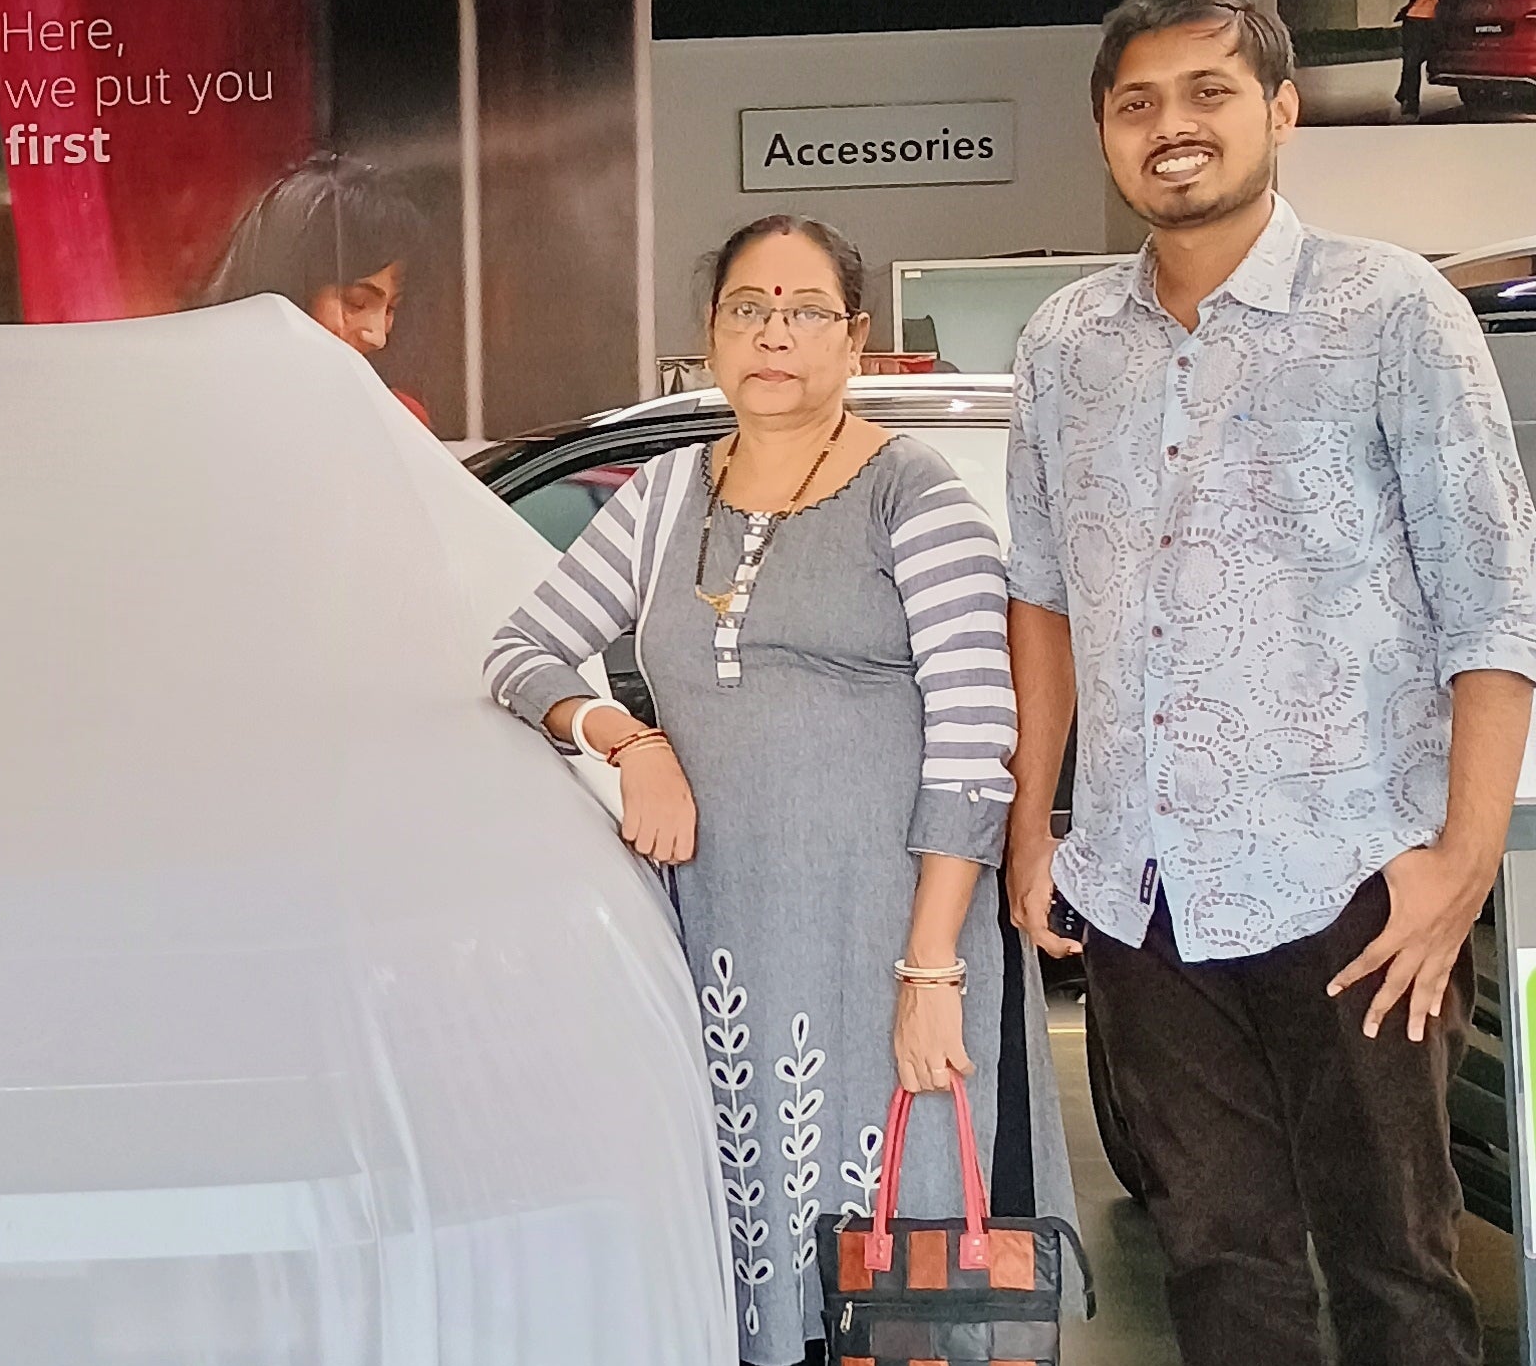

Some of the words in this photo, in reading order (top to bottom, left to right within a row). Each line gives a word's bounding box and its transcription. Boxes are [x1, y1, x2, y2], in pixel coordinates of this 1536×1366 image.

[2, 10, 124, 58] Here,
[4, 77, 76, 109] we
[95, 68, 172, 117] put
[186, 70, 274, 115] you
[5, 123, 111, 166] first
[764, 127, 994, 167] Accessories
